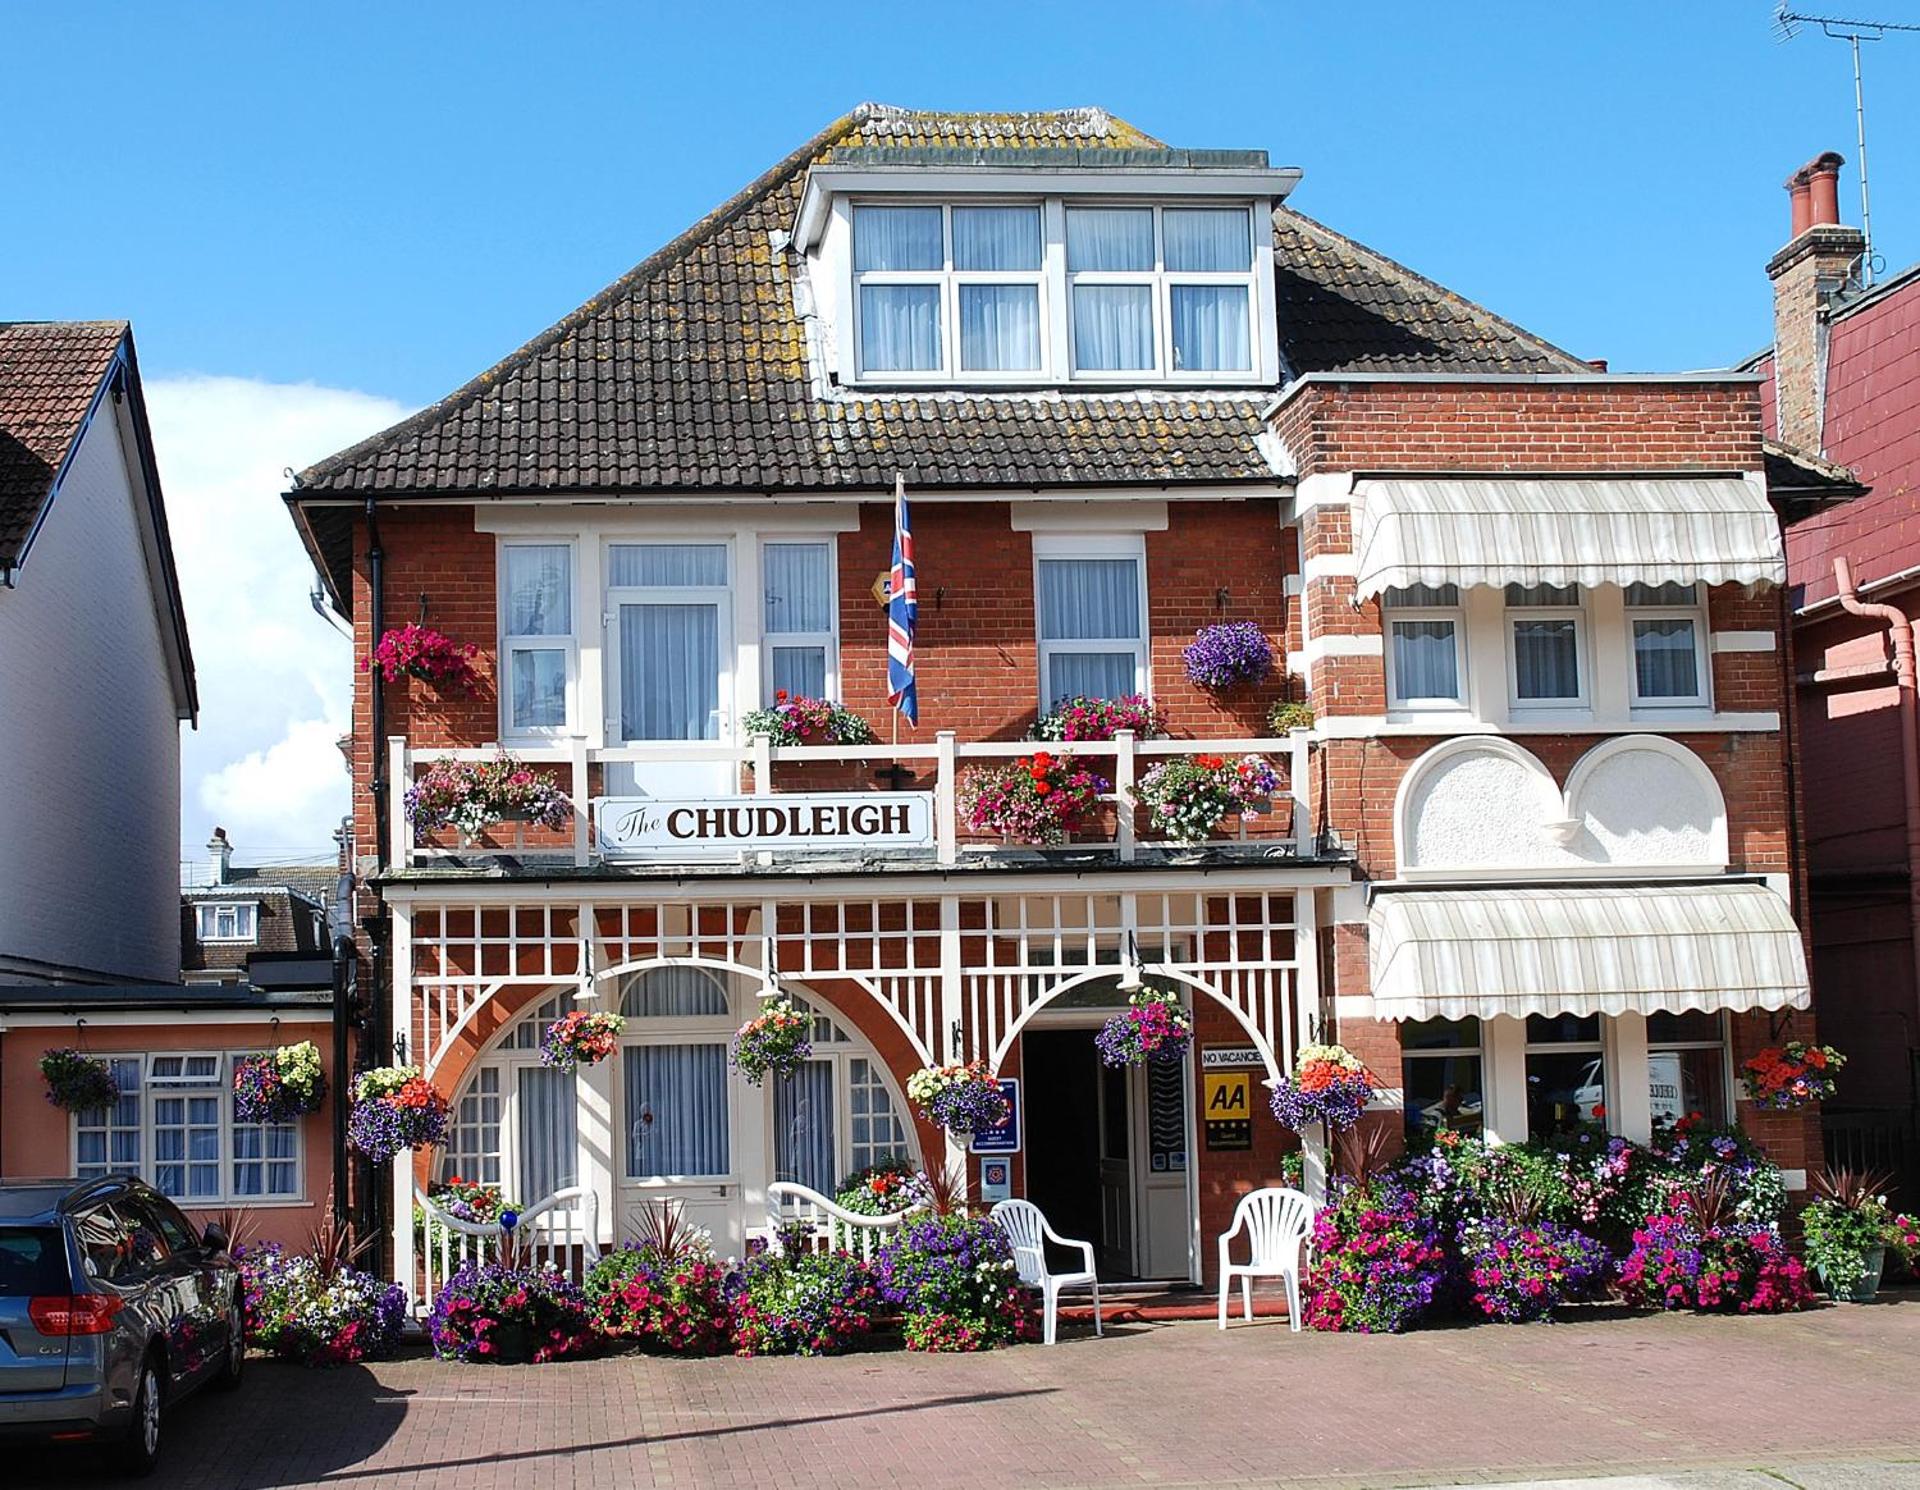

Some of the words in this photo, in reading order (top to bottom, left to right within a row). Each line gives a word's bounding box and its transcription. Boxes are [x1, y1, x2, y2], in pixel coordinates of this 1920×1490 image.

[615, 807, 660, 841] The
[667, 805, 911, 838] CHUDLEIGH
[1203, 1053, 1217, 1063] NO
[1210, 1085, 1245, 1110] AA
